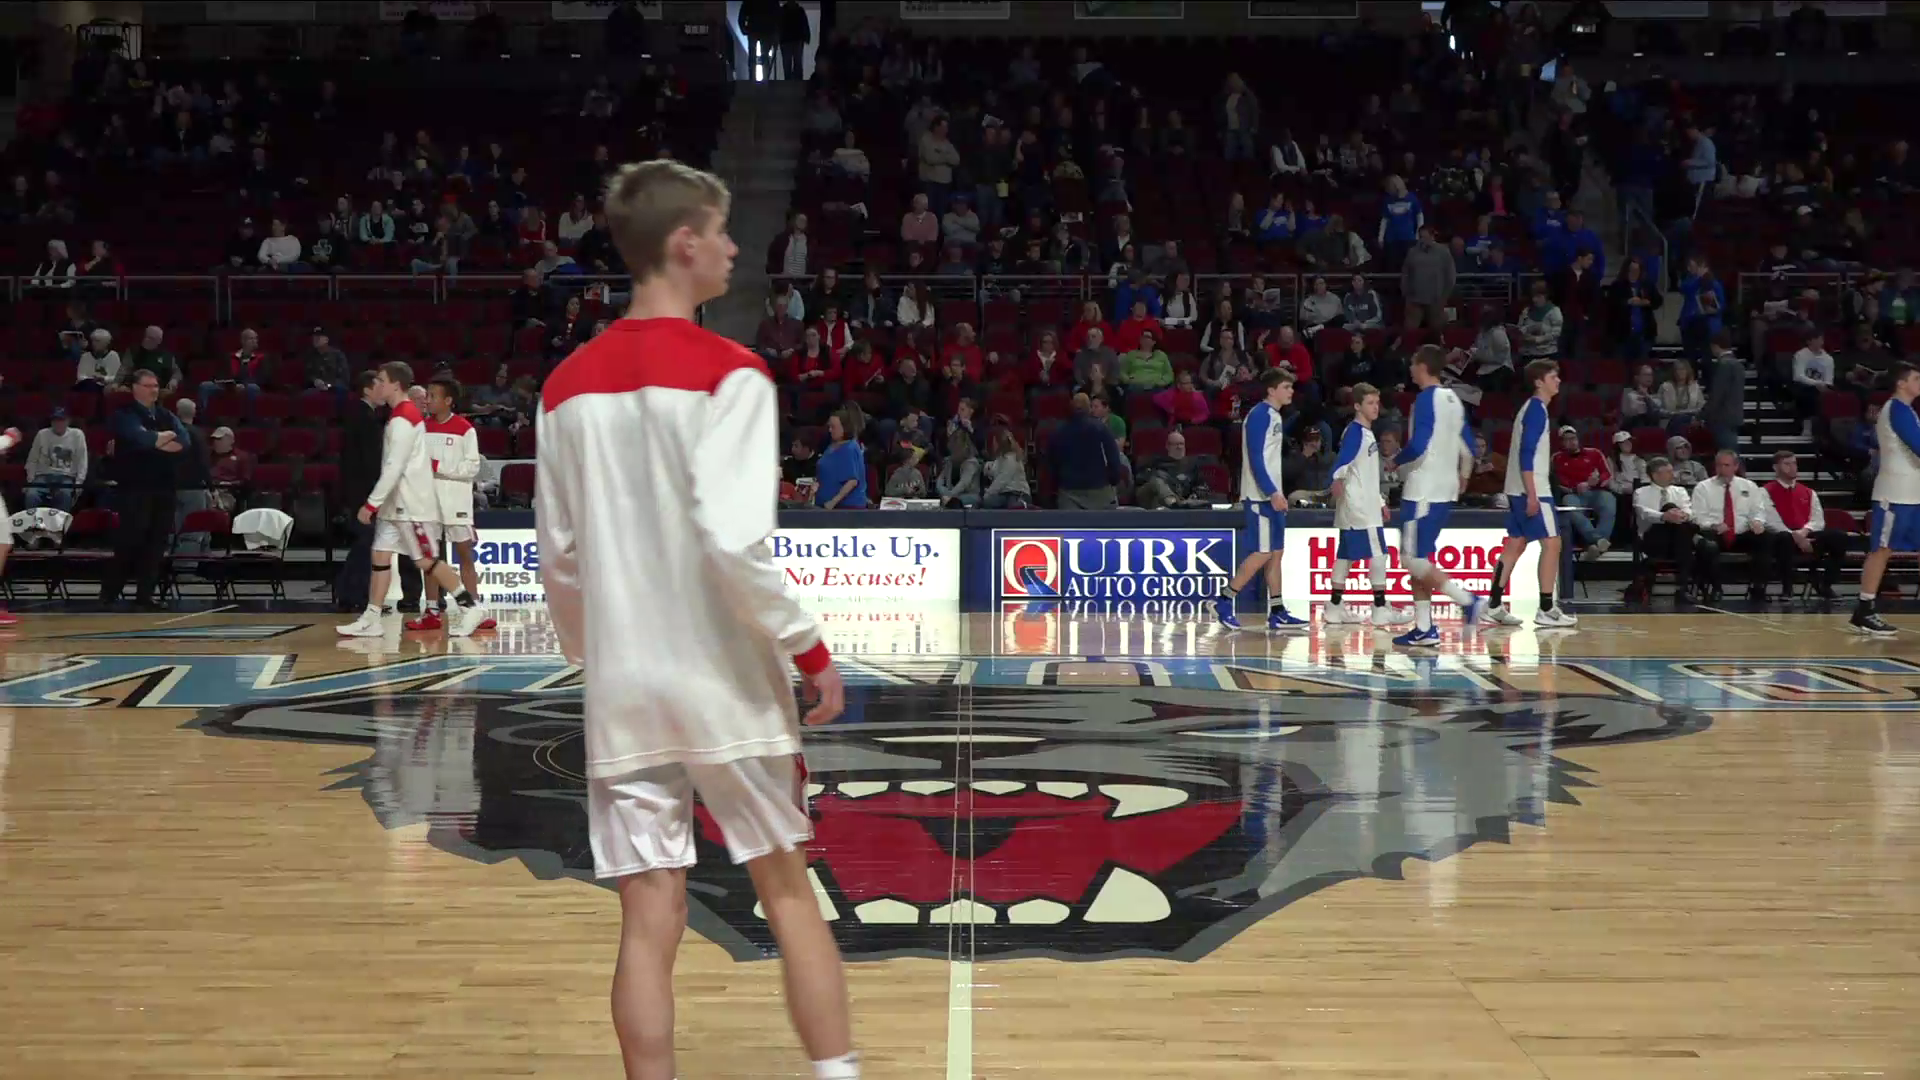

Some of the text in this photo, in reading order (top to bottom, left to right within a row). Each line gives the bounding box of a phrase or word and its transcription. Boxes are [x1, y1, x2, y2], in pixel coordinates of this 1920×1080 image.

[772, 536, 940, 565] Buckle Up.
[1308, 536, 1510, 569] Hond
[783, 567, 927, 586] No Excuses!
[1004, 538, 1230, 595] QUIRK
[1065, 575, 1229, 597] AUTO GROUP
[1315, 573, 1397, 591] Lumbr
